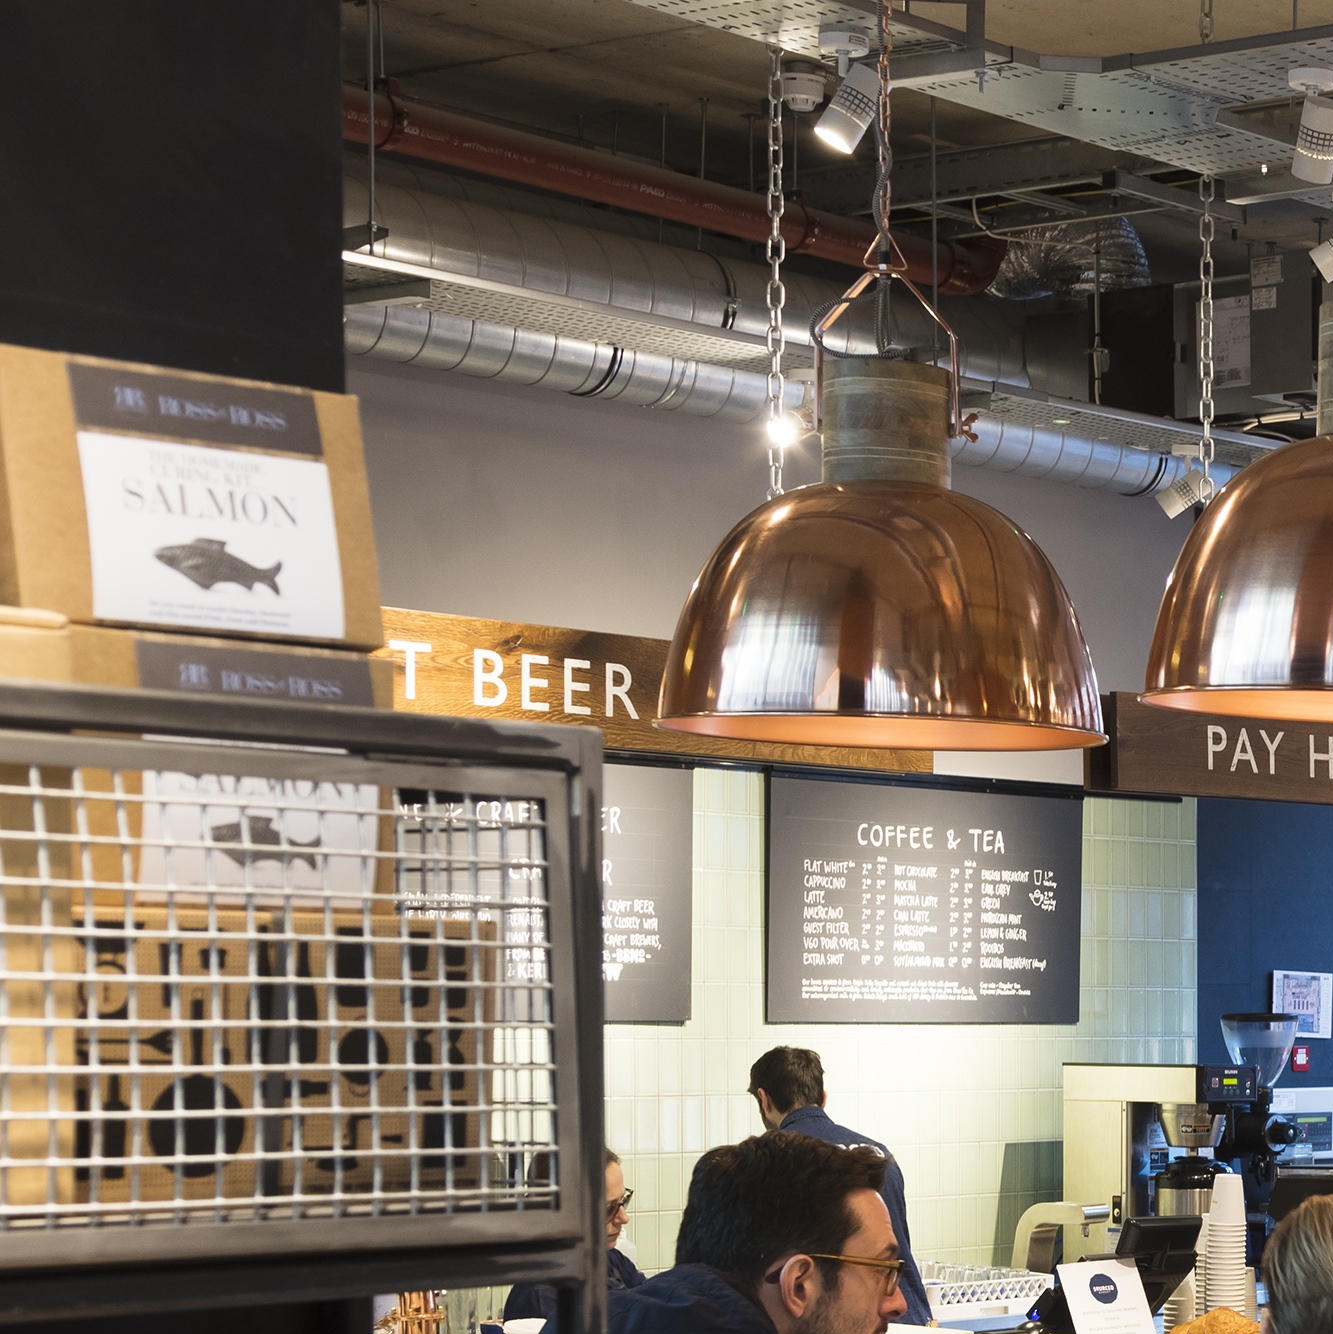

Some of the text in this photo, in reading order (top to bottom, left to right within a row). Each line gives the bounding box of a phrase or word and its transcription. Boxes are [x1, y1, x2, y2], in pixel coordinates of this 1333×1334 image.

[121, 475, 297, 527] SALMON
[471, 647, 640, 721] BEER
[1206, 724, 1285, 776] PAY
[476, 801, 538, 827] CRAF
[857, 823, 1005, 854] COFFEE & TEA
[803, 859, 848, 873] FLAT WHITE
[803, 875, 846, 889] CAPPUCCINO
[894, 879, 917, 892] MOCHA
[804, 890, 825, 904] LATTE
[995, 884, 1011, 897] GREY
[607, 899, 655, 916] CRAFT BEER
[894, 894, 939, 908] MATCHA LATTE
[981, 897, 1000, 911] GREEN
[893, 909, 930, 923] CHAI LATTE
[614, 915, 641, 930] CLOSELY
[642, 916, 659, 932] WITH
[803, 922, 850, 935] GUEST FILTER
[894, 924, 923, 937] ESPRESSO
[981, 928, 999, 939] LEMON
[1005, 928, 1027, 941] GINGER
[604, 933, 629, 947] CRAFT
[630, 933, 663, 951] BREWERS,
[803, 936, 860, 952] V60 POUR OVER
[803, 953, 844, 966] EXTRA SHOT
[1003, 956, 1031, 970] BREAKFAST
